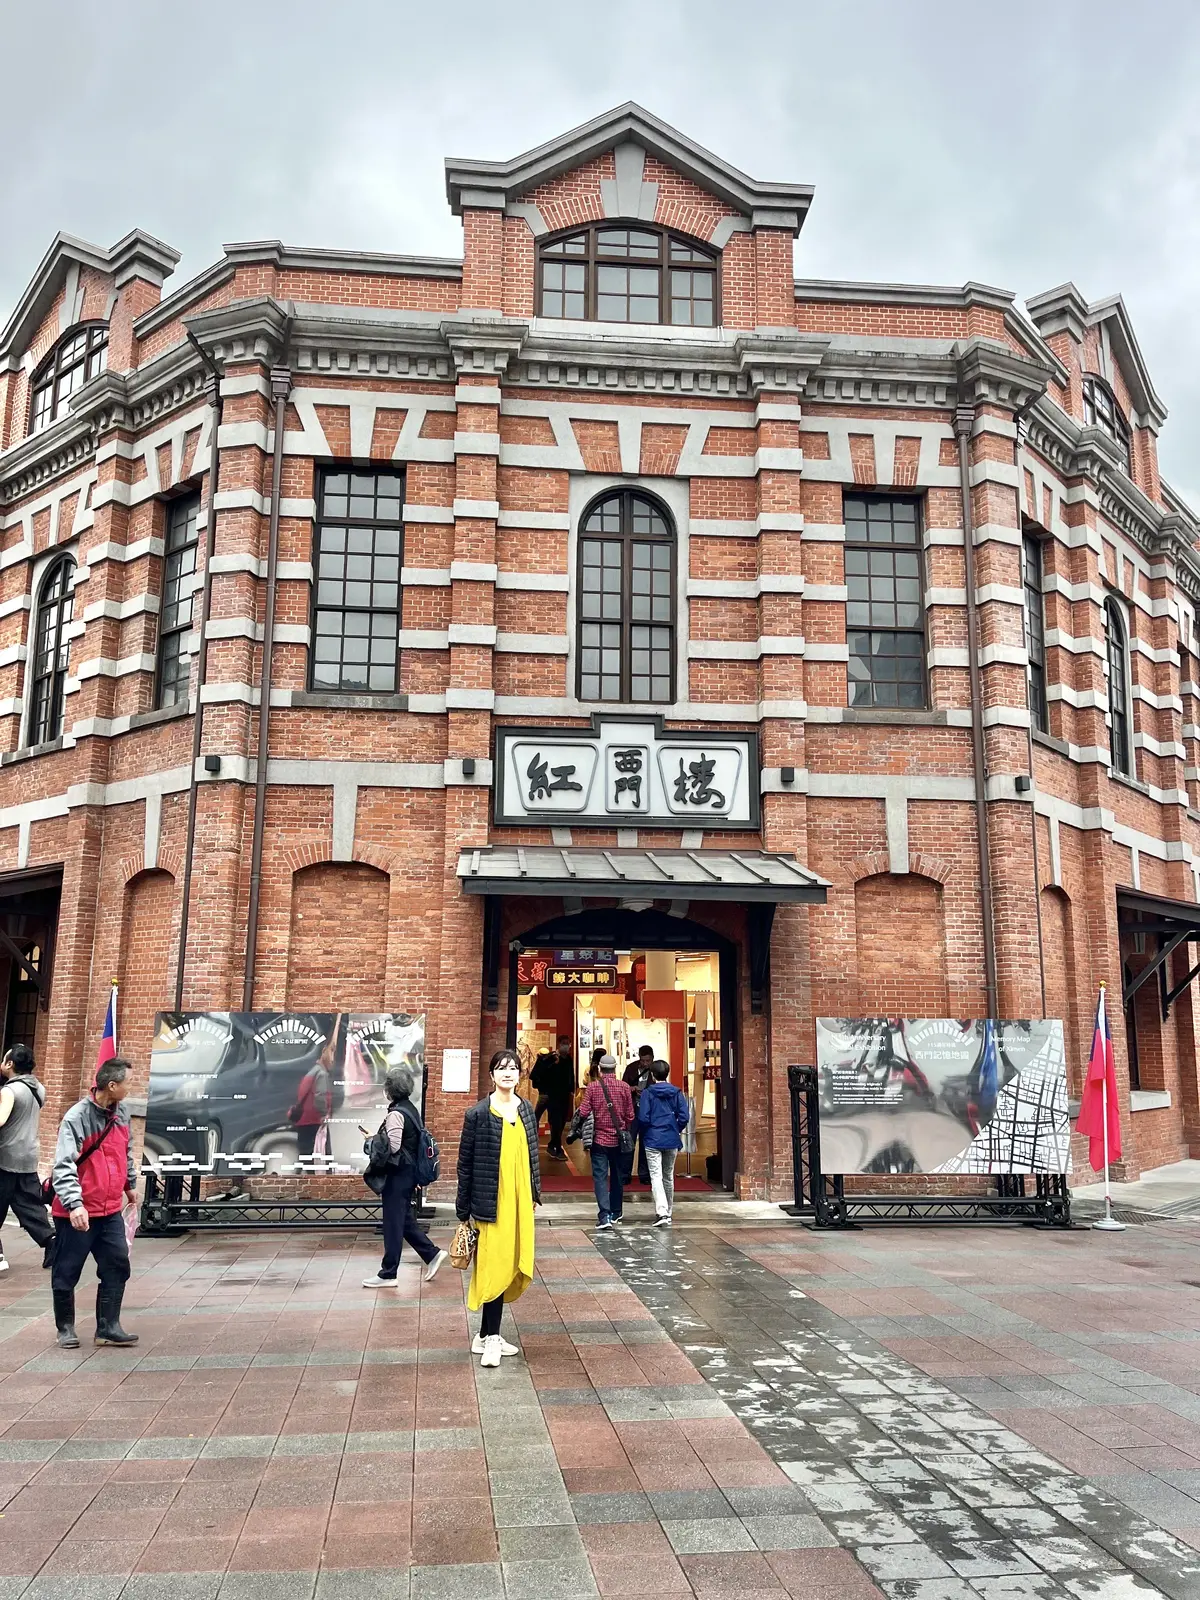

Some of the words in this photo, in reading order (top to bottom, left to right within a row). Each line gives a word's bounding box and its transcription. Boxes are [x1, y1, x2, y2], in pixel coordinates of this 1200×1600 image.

[527, 752, 583, 801] 紅
[614, 749, 642, 808] 西門
[552, 972, 610, 984] 蜂大咖啡
